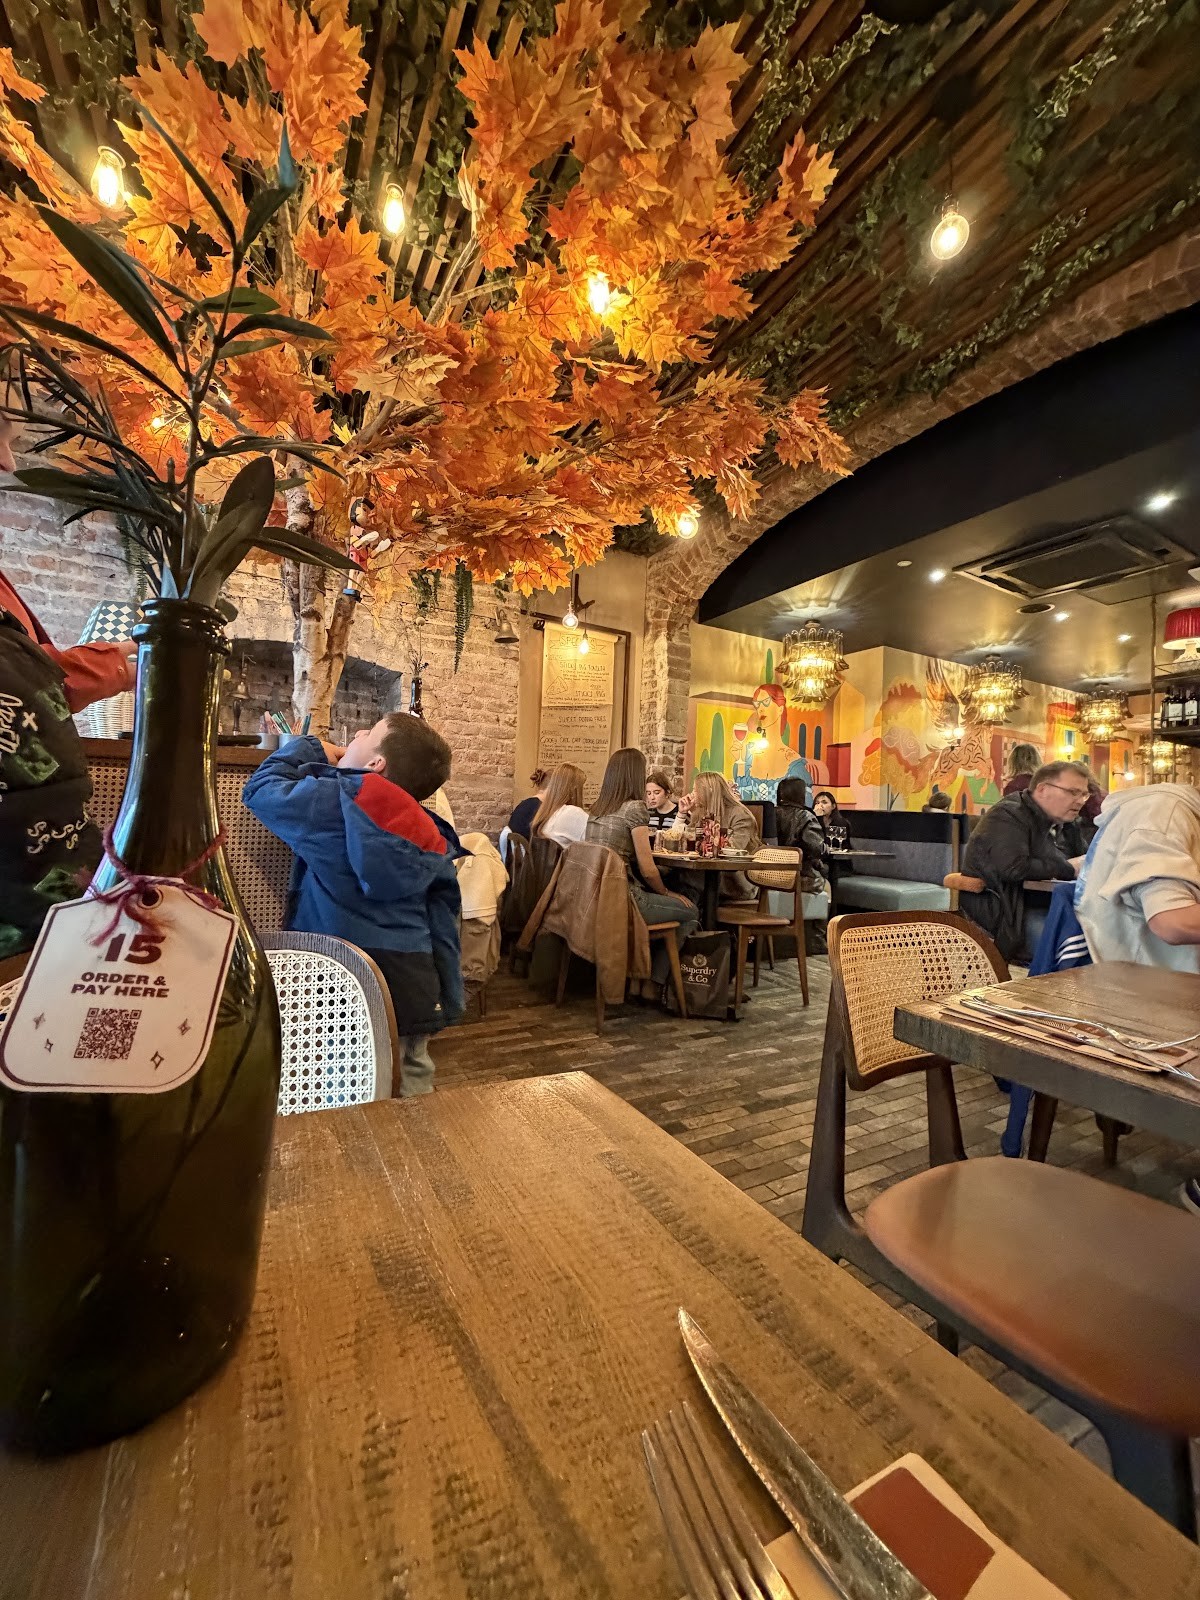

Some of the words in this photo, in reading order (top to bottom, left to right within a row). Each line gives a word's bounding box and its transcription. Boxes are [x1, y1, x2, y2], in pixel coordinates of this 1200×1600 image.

[560, 636, 596, 650] SPECS
[104, 933, 166, 965] 15
[680, 964, 717, 977] Superdry
[81, 972, 149, 985] ORDER
[153, 975, 167, 986] &
[695, 974, 709, 983] Co
[71, 983, 112, 996] PAY
[114, 986, 169, 998] HERE
